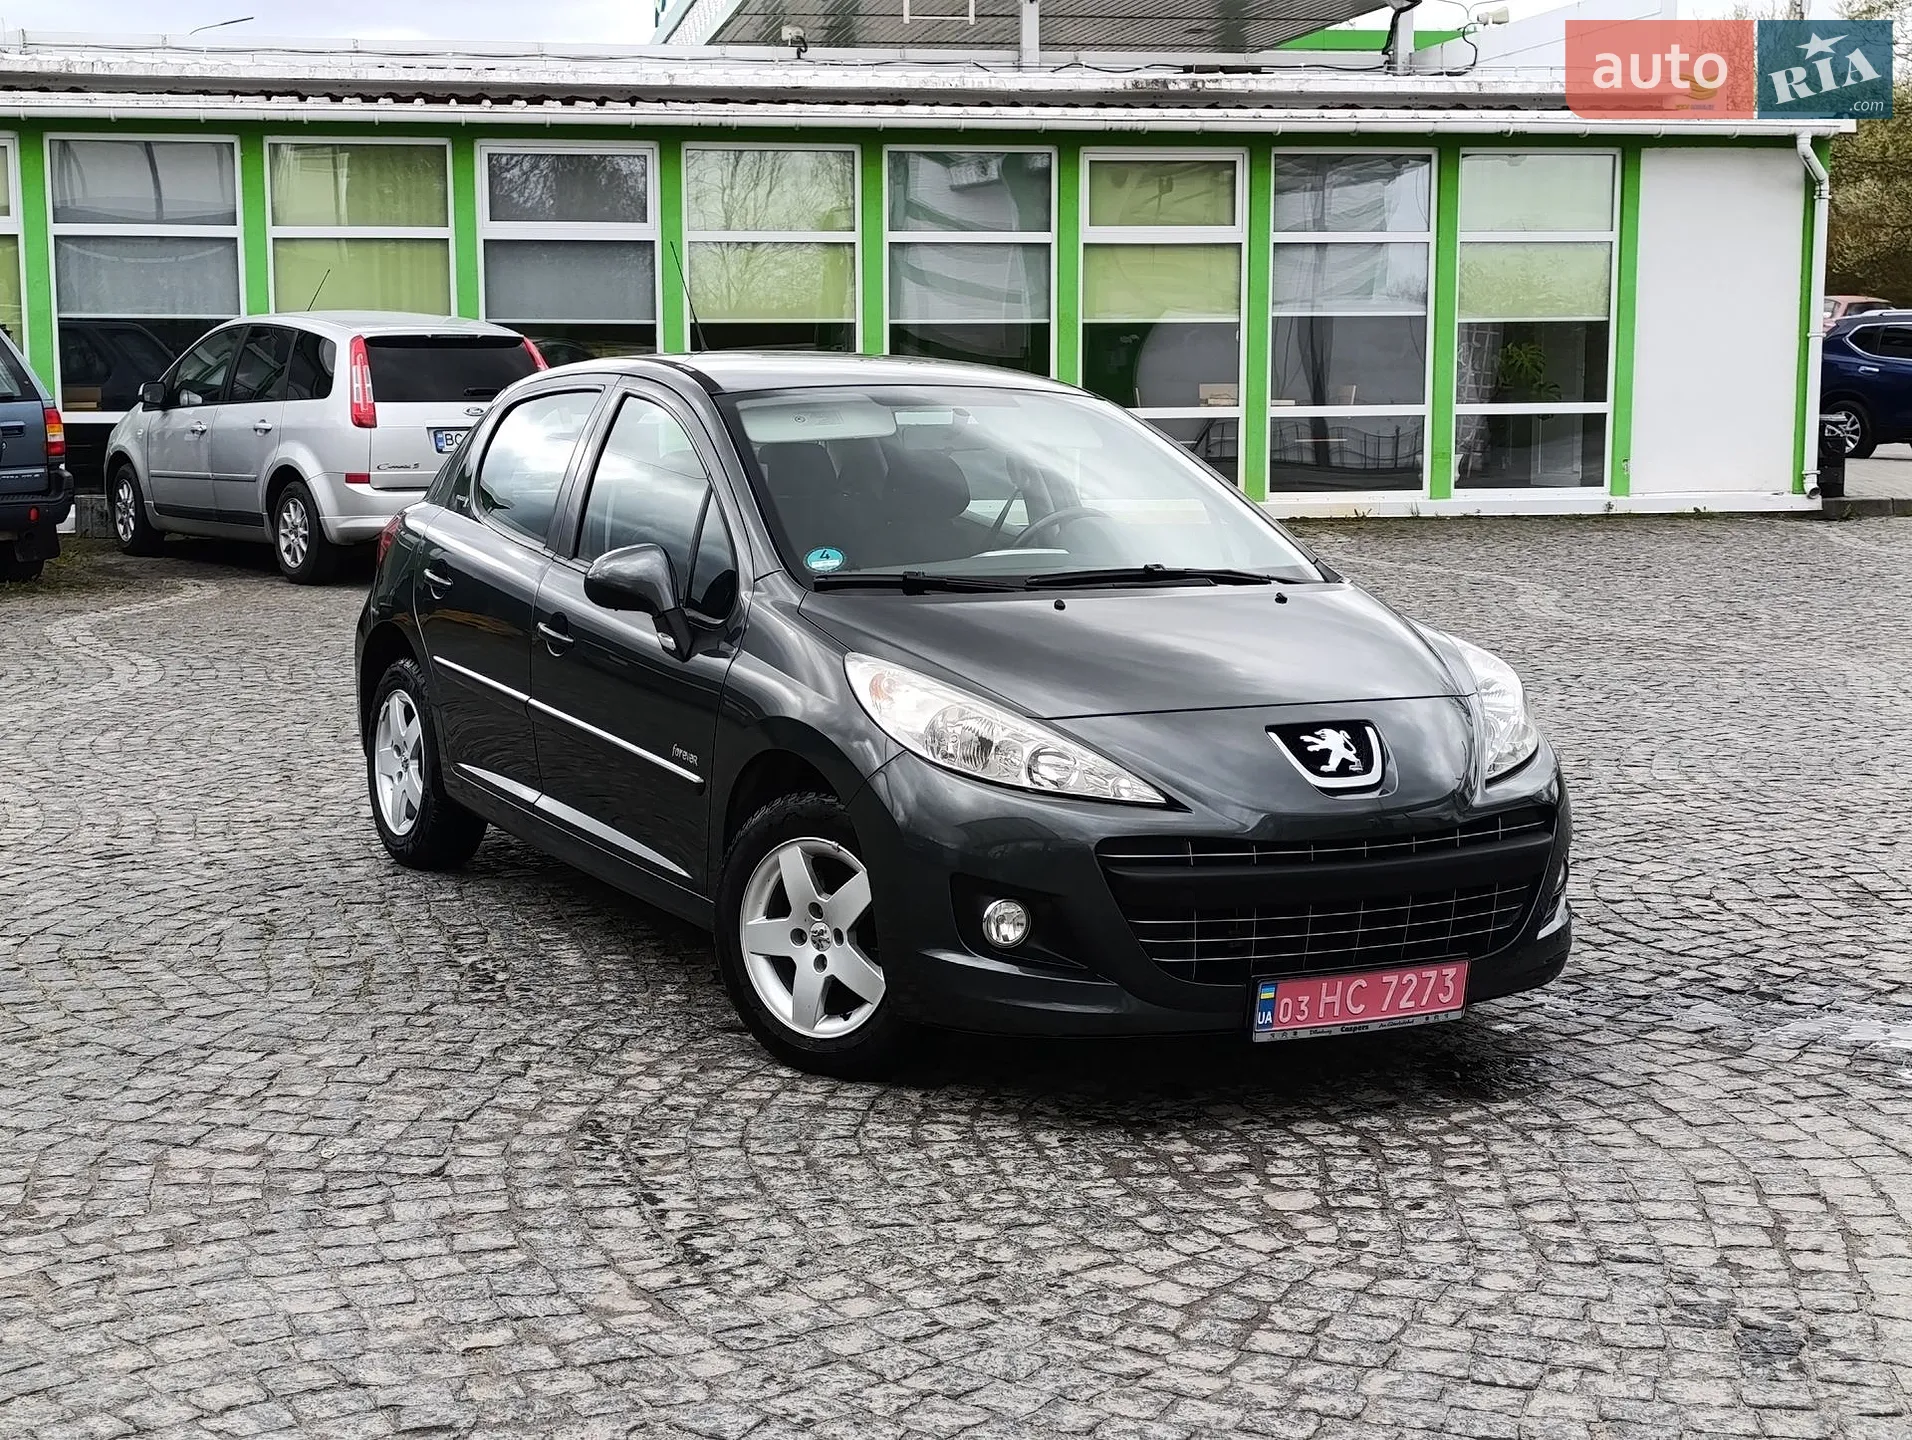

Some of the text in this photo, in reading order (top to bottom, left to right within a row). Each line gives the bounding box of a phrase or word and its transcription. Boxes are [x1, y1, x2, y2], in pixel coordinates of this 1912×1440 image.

[820, 549, 830, 559] 4
[1278, 967, 1457, 1023] 03 HC 7273
[1257, 1011, 1273, 1025] UA
[1340, 1024, 1369, 1033] Caspers
